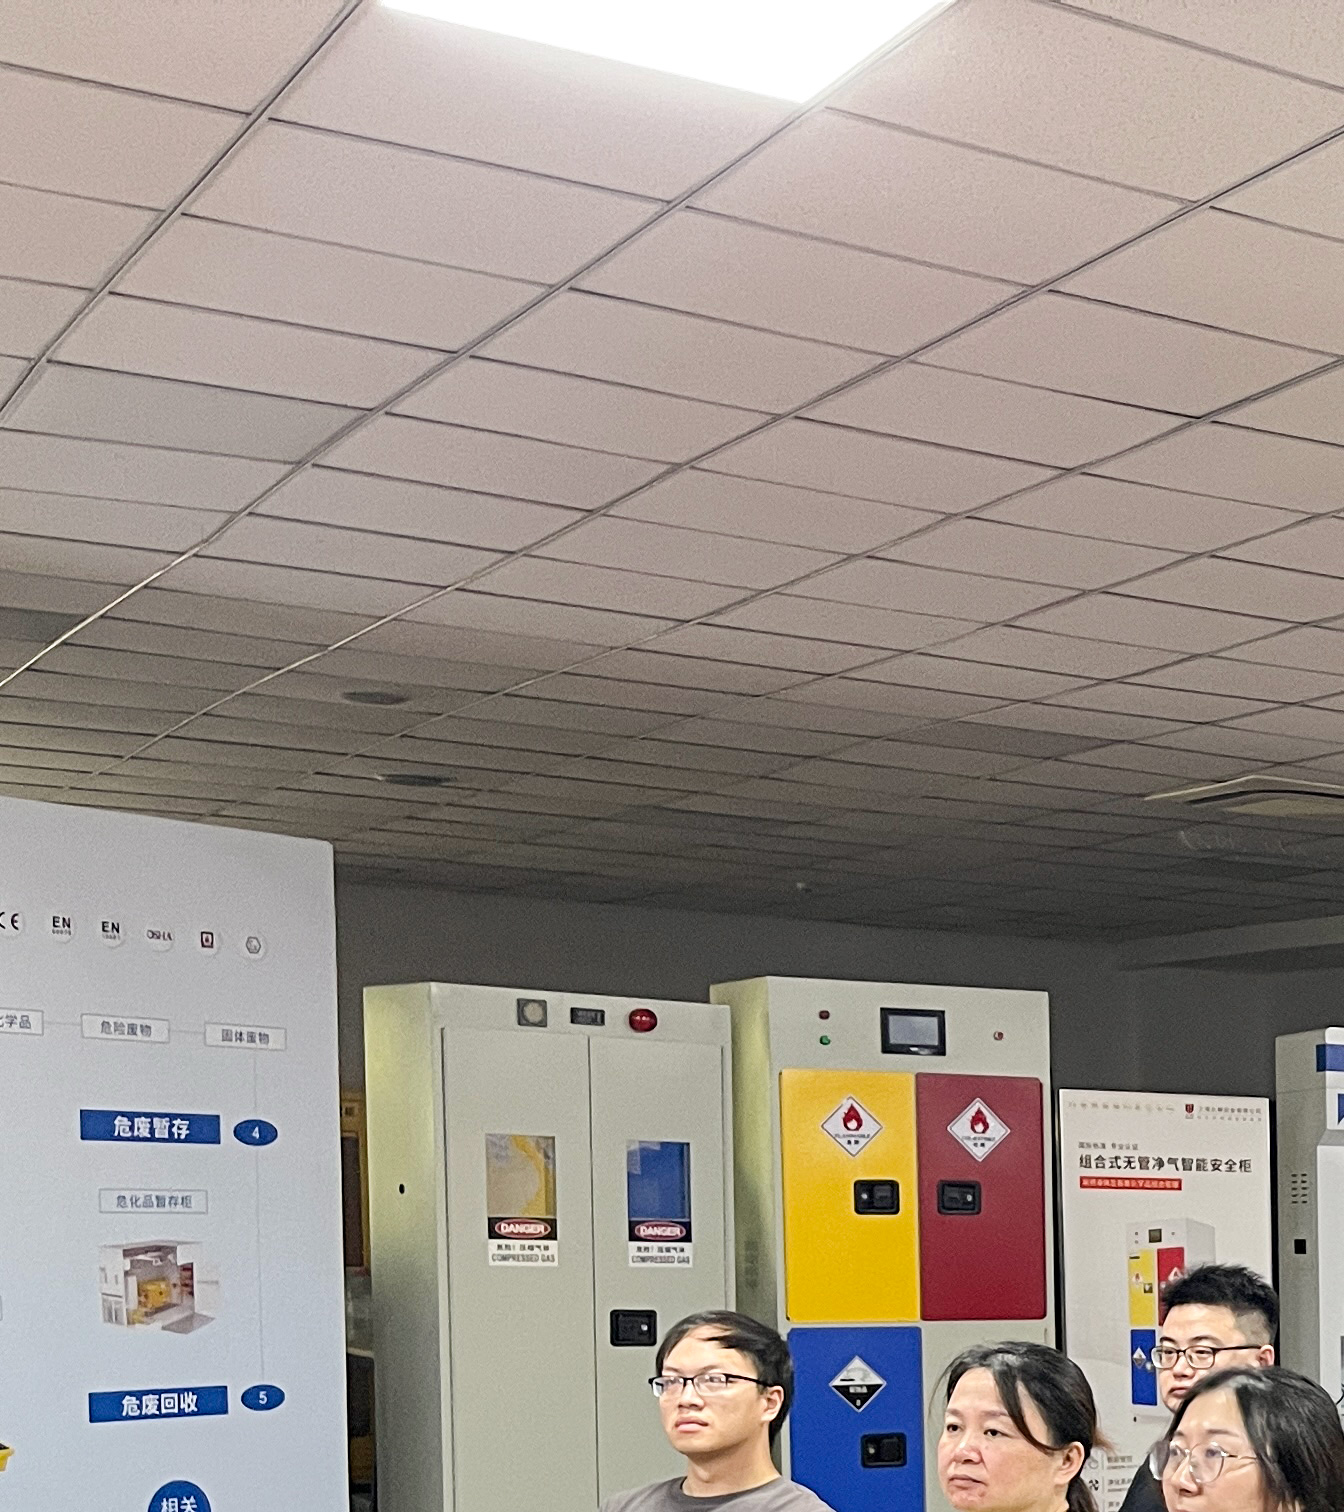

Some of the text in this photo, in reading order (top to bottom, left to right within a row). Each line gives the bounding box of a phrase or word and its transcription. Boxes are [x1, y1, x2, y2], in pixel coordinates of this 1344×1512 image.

[52, 916, 71, 928] EN
[101, 921, 120, 934] EN
[113, 1115, 190, 1139] 危废暂存
[251, 1126, 260, 1139] 4
[1079, 1154, 1252, 1173] 组合式无管净气智能安全柜
[500, 1222, 546, 1234] DANGER
[639, 1227, 681, 1238] DANGER
[121, 1391, 198, 1417] 危废回收
[258, 1391, 268, 1404] 5
